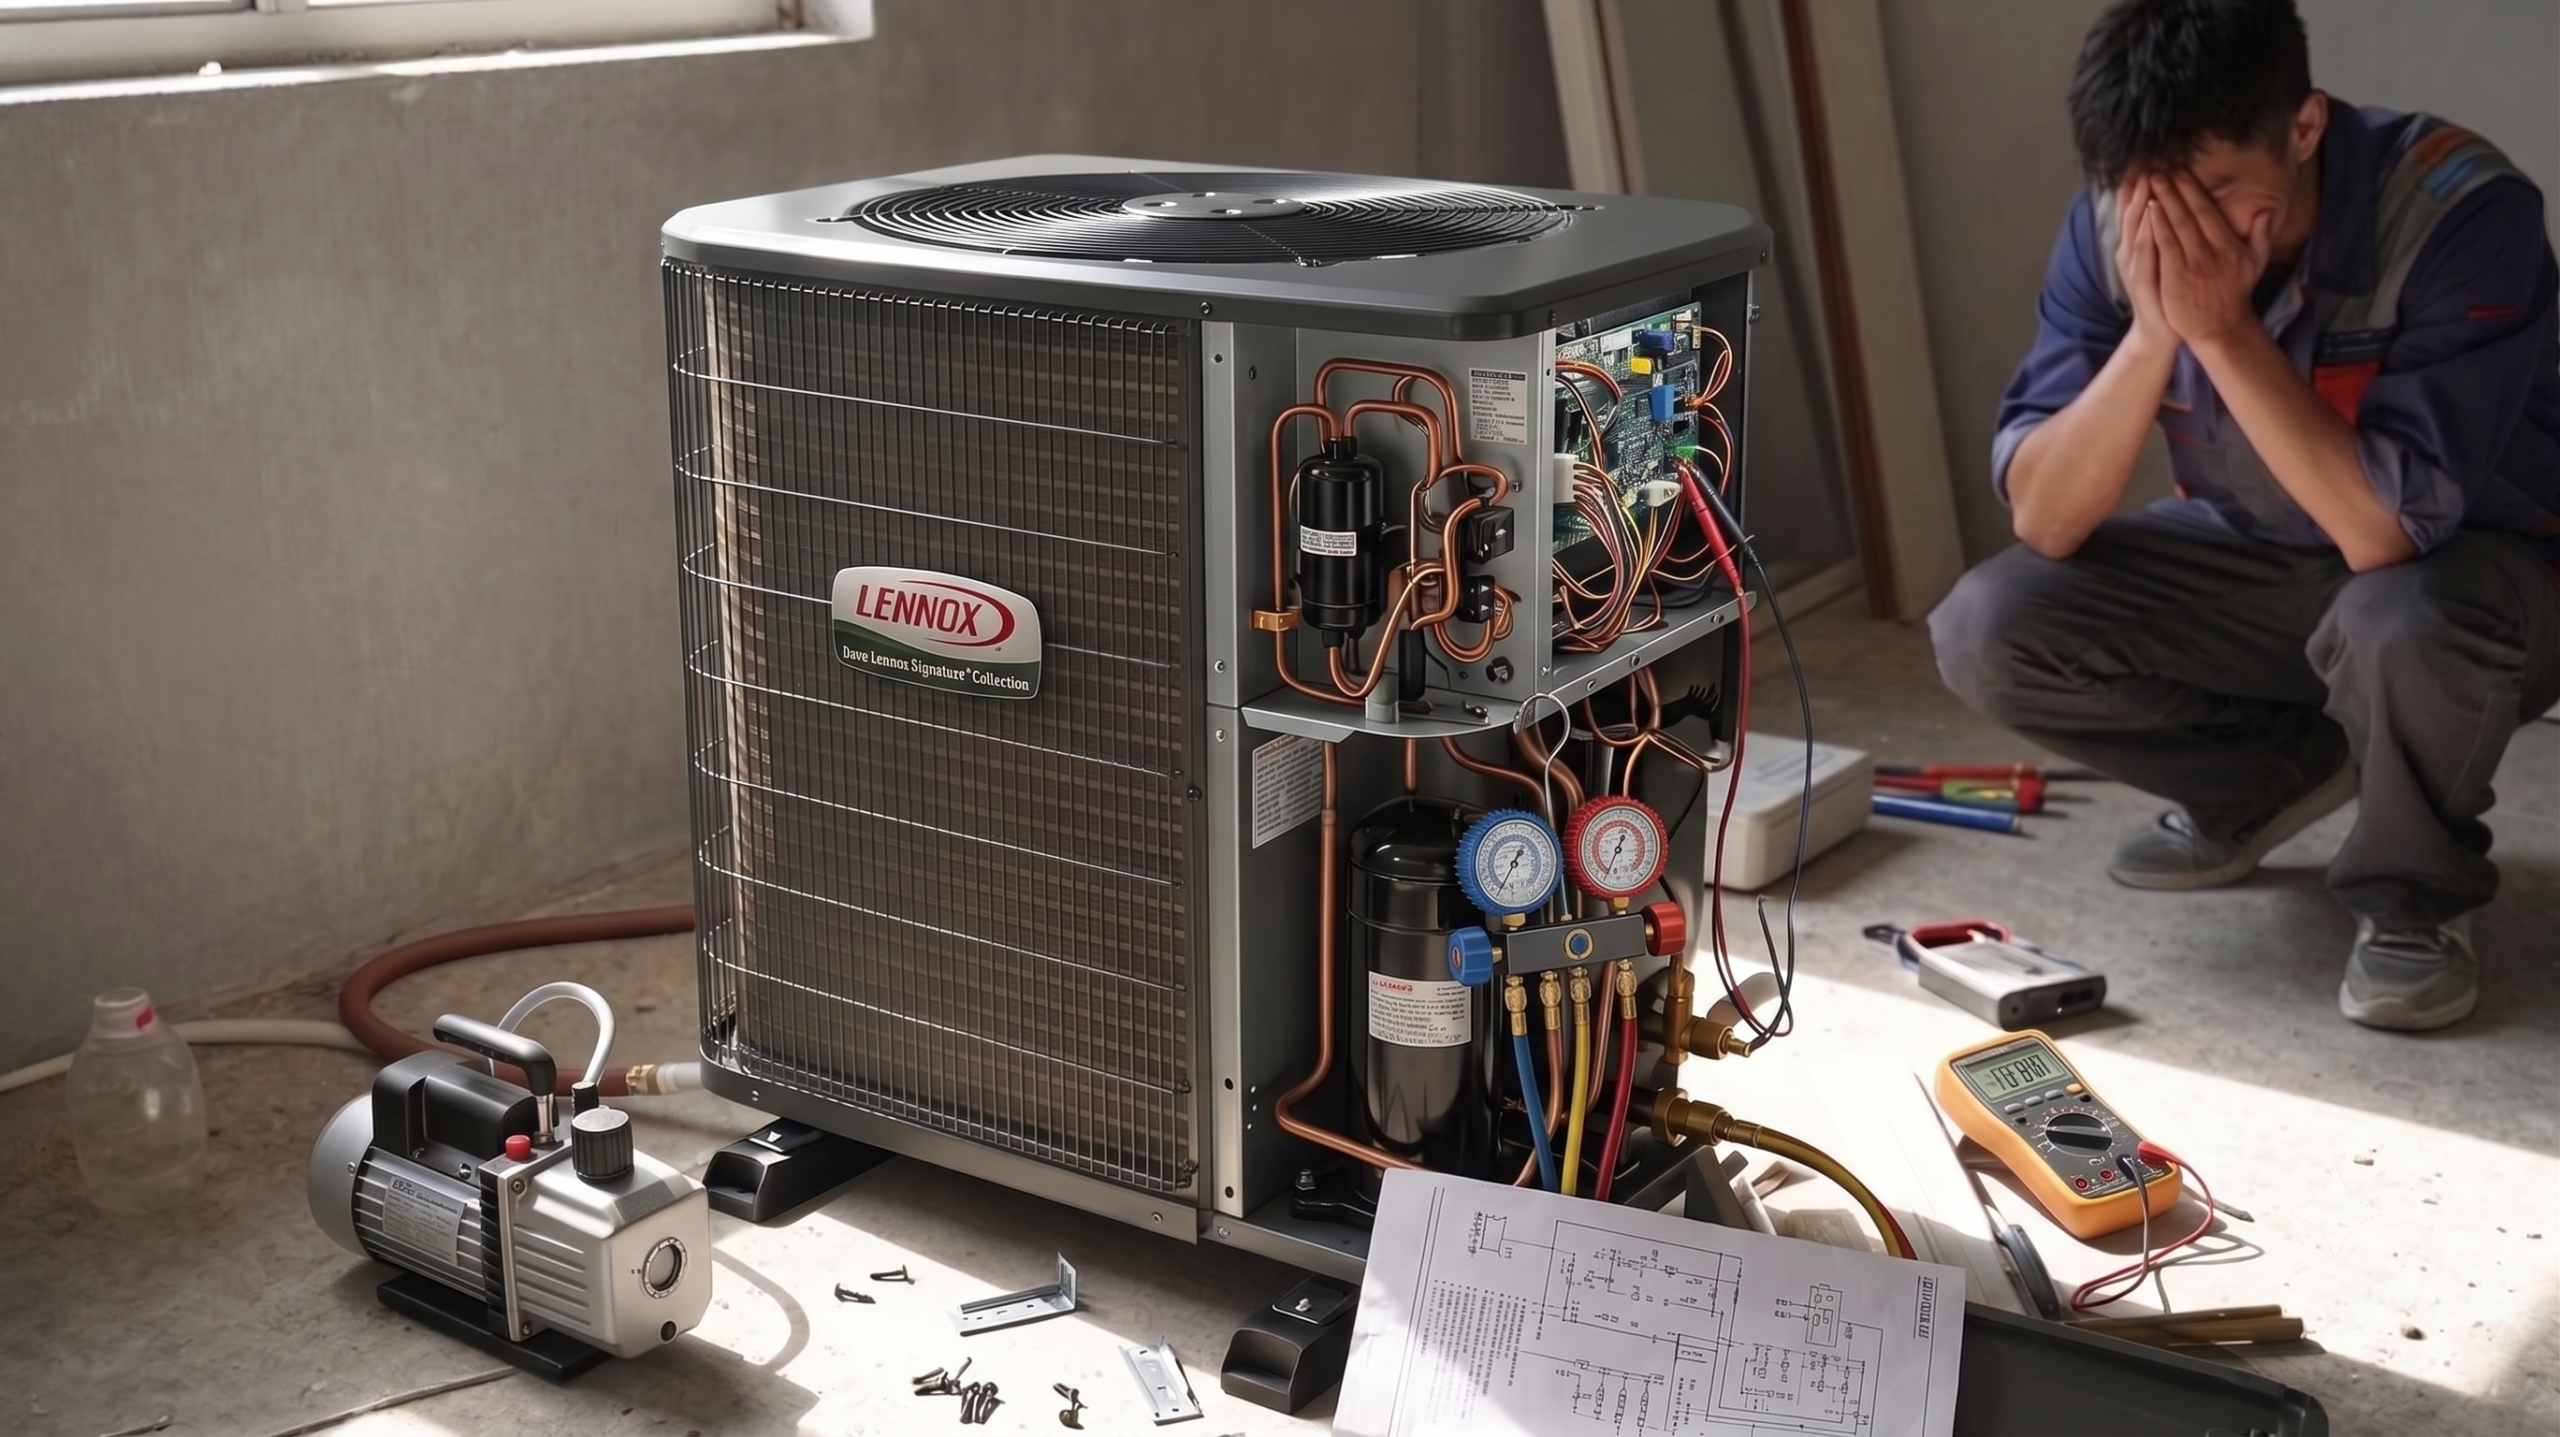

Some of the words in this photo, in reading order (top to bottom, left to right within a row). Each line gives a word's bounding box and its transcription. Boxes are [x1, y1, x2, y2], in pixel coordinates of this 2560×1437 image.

[855, 584, 983, 637] LENNOX
[843, 645, 869, 663] Dave
[972, 669, 1030, 691] Collection
